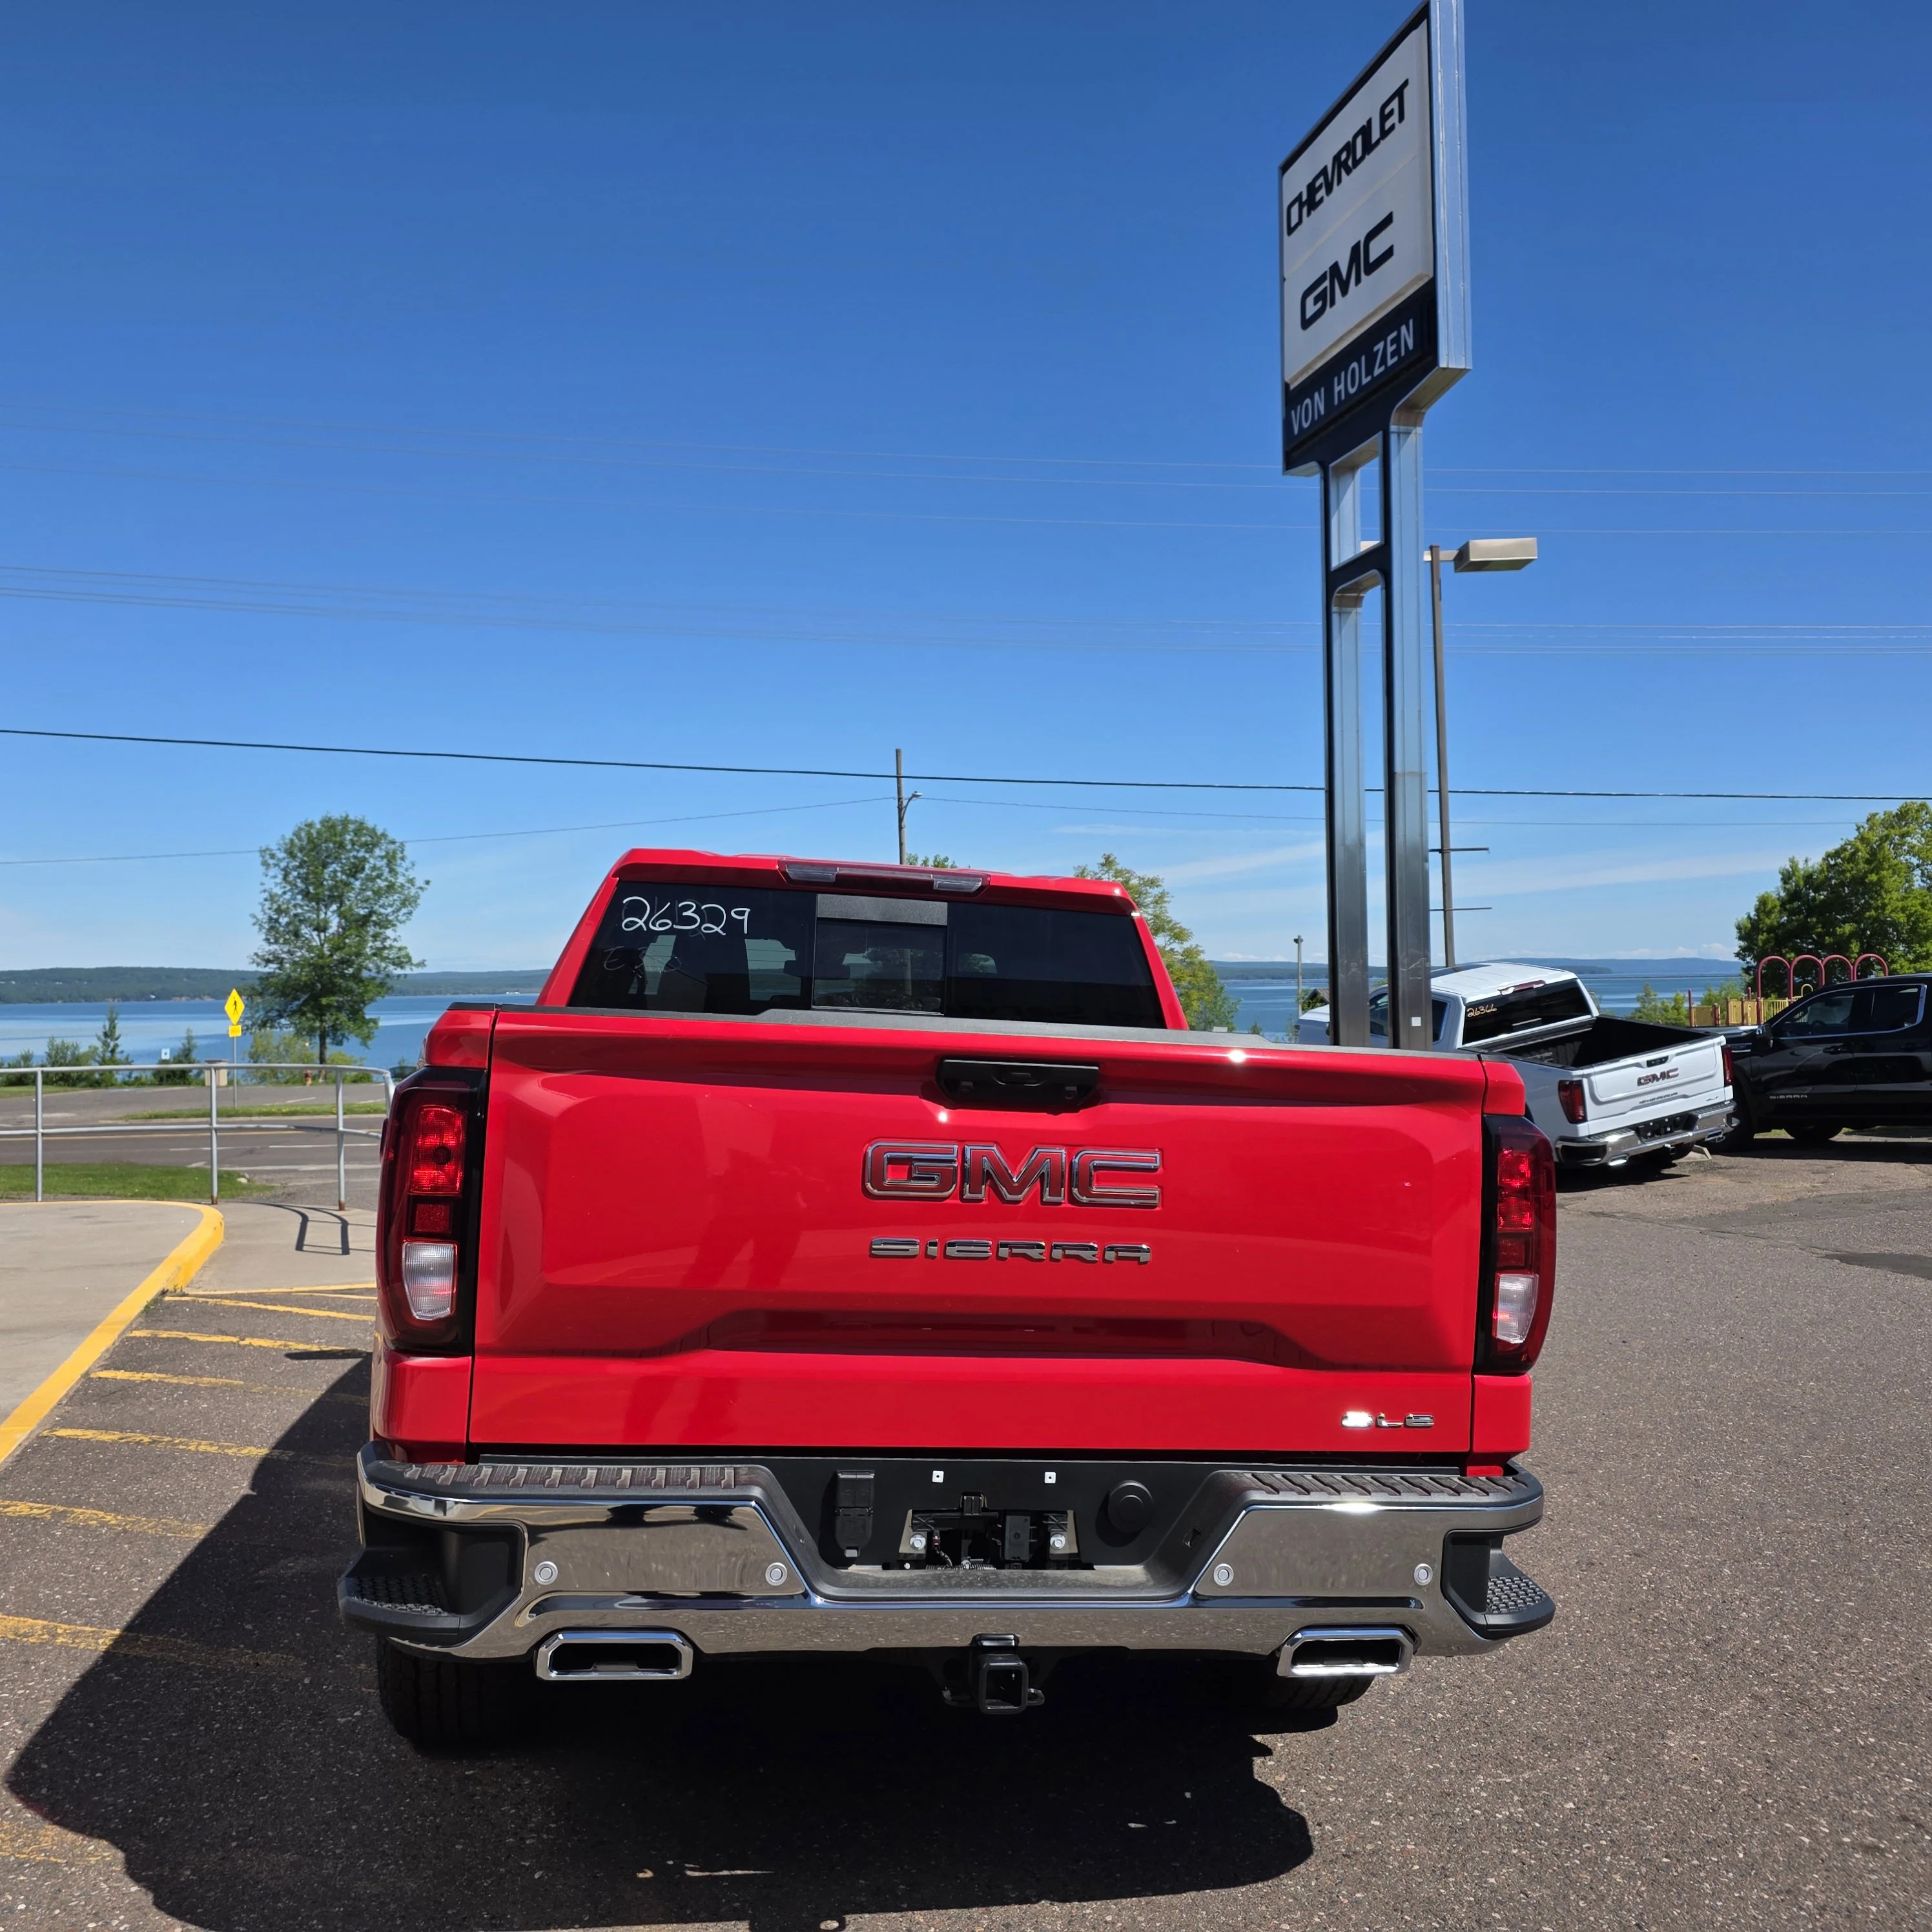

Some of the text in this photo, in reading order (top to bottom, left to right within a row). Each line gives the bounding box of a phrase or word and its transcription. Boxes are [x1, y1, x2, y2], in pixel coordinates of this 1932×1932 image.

[1286, 78, 1409, 237] CHEVROLET
[1299, 211, 1394, 331] GMC
[1291, 319, 1414, 436] VON HOLZEN
[621, 896, 750, 936] 26329
[1466, 1003, 1497, 1018] 26366
[1637, 1067, 1679, 1087] GMC
[864, 1140, 1161, 1206] GMC
[870, 1237, 1152, 1264] SIERRA
